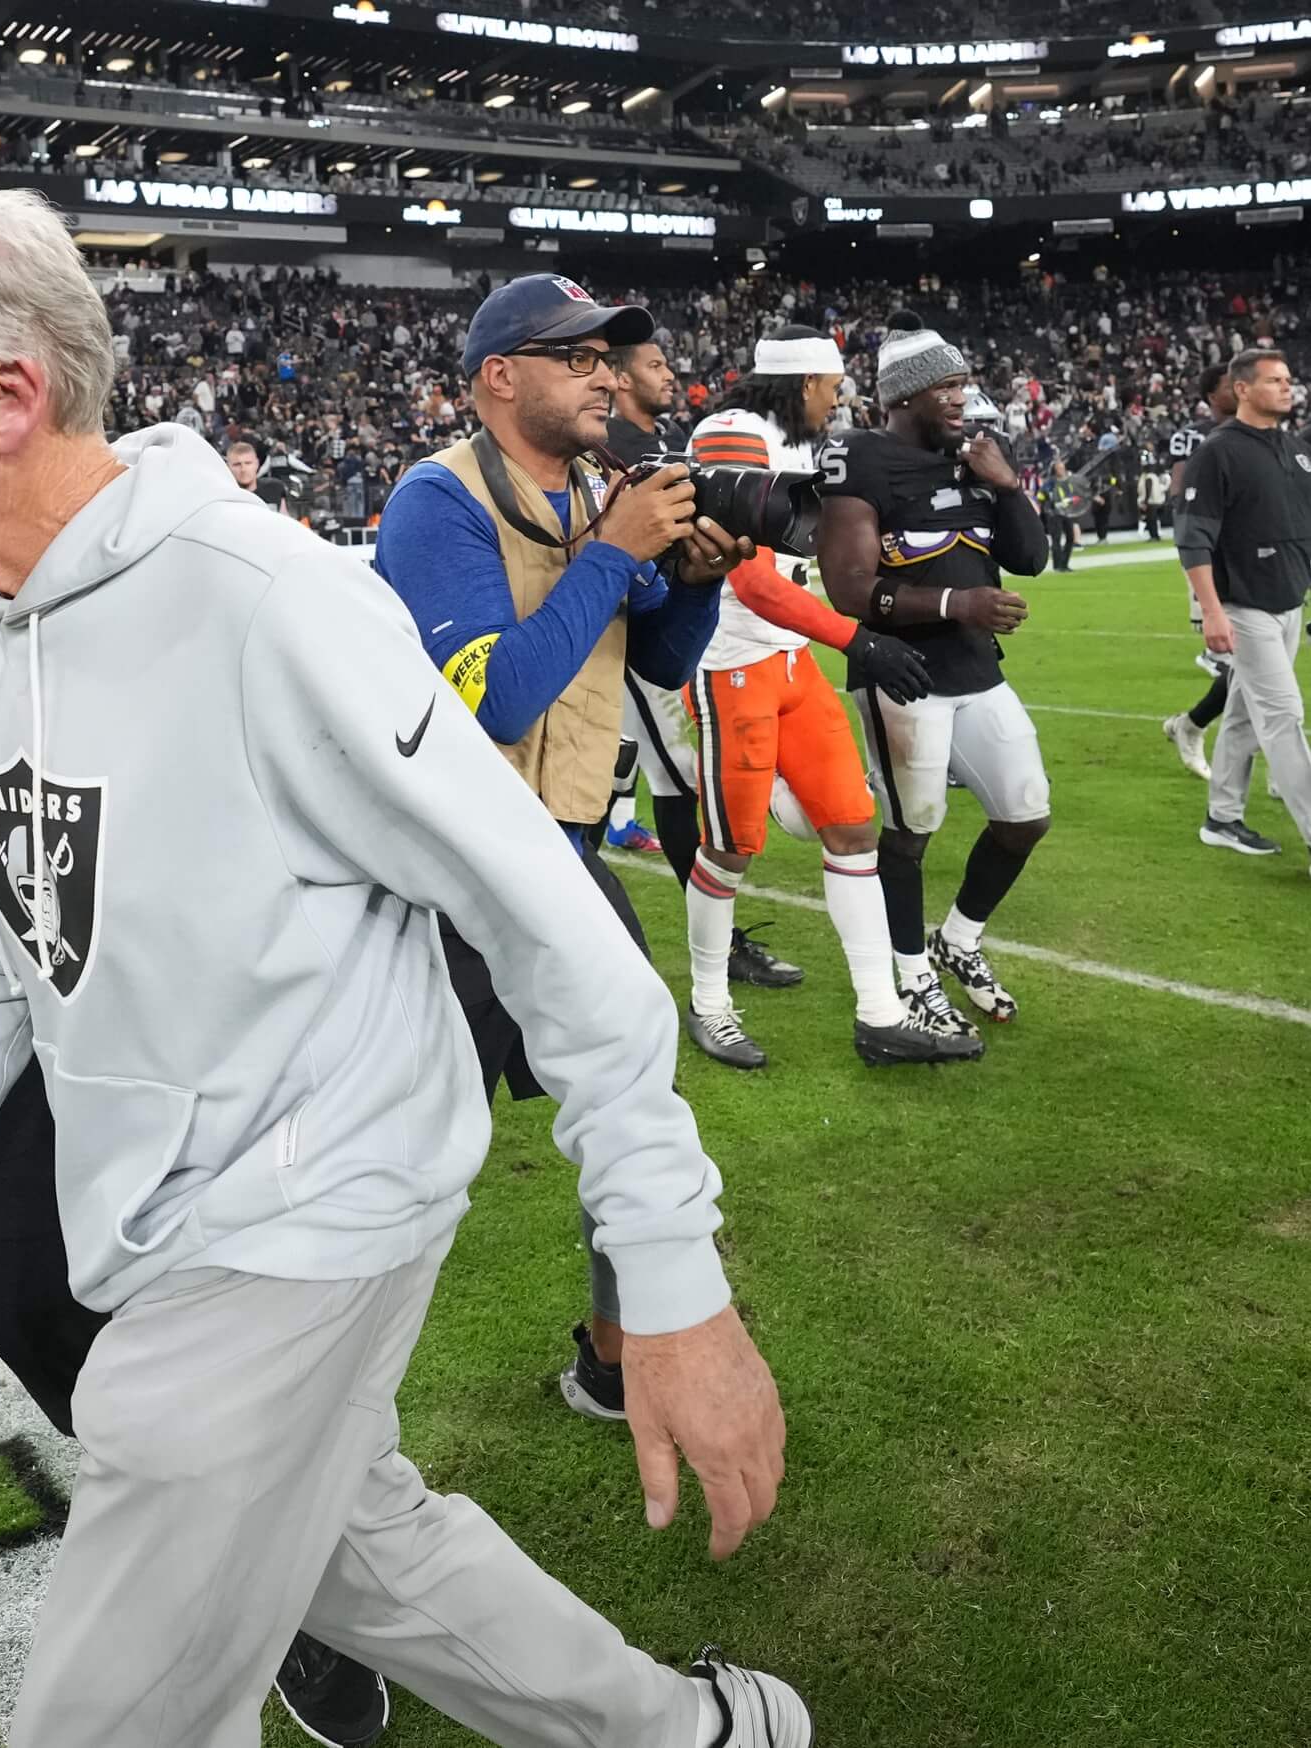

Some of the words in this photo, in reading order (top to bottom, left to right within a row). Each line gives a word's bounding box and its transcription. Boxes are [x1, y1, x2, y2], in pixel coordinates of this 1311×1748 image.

[436, 12, 552, 44] CLEVELAND
[555, 26, 639, 52] BROWNS
[84, 179, 137, 204] LAS
[139, 181, 229, 209] VEGAS
[232, 187, 338, 214] RAIDERS
[1122, 191, 1166, 211] LAS
[1168, 184, 1252, 210] VEGAS
[509, 207, 629, 232] CLEVELAND
[631, 213, 716, 235] BROWNS
[452, 648, 481, 687] WEEK
